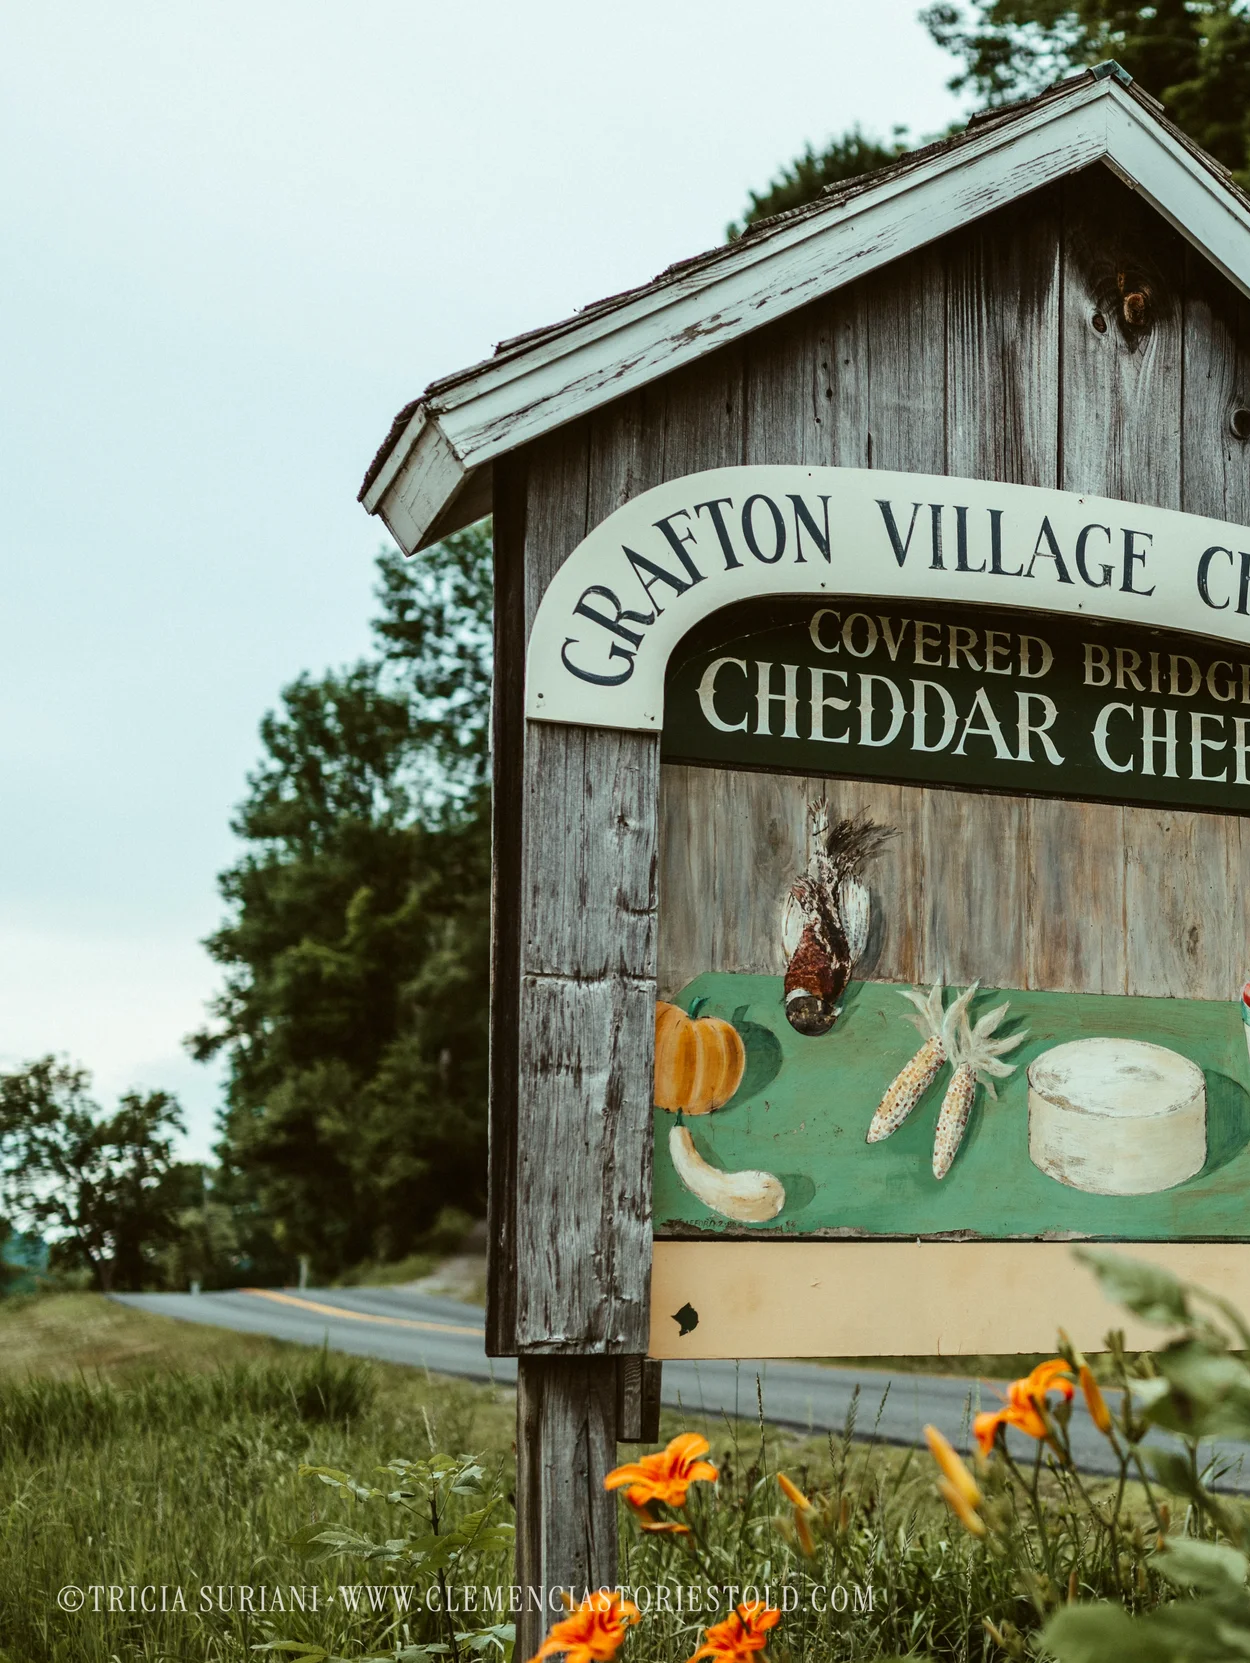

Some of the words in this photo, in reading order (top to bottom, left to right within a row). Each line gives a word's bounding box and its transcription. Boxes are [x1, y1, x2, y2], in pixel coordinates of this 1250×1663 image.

[561, 494, 832, 686] GRAFTON
[875, 499, 1155, 597] VILLAGE
[809, 608, 1055, 678] COVERED
[695, 657, 1066, 768] CHEDDAR
